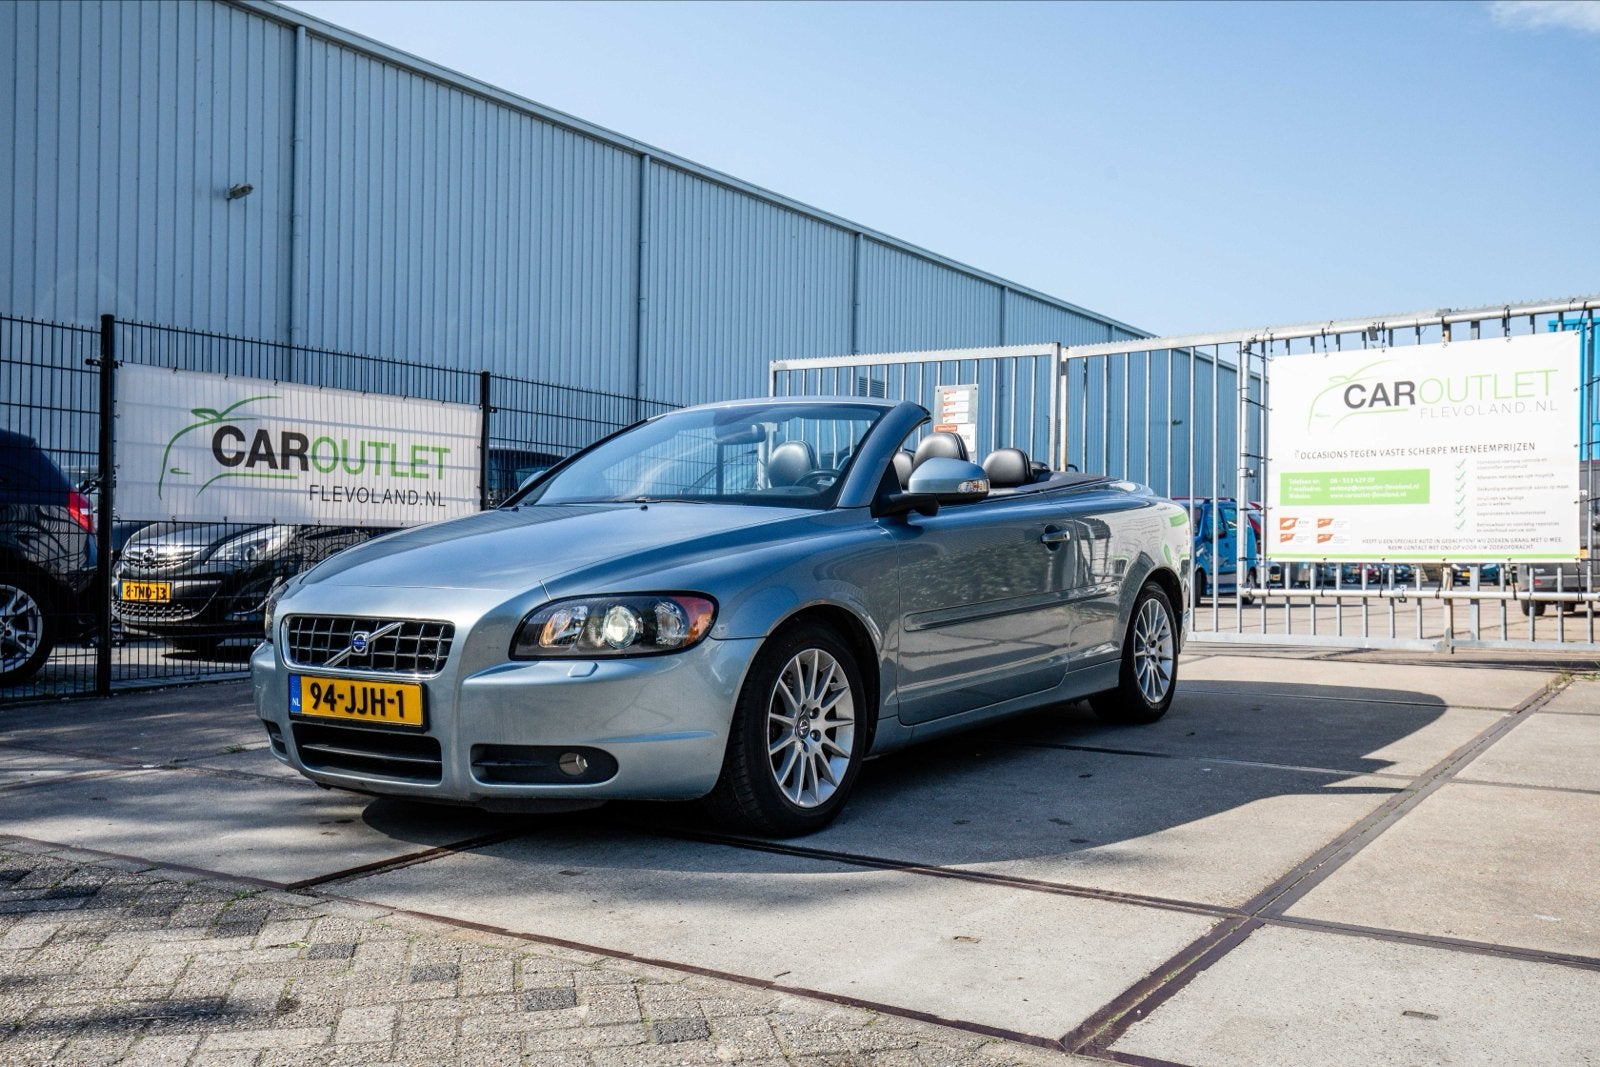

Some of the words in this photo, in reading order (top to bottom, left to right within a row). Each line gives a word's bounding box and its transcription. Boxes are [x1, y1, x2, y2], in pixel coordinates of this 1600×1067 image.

[1343, 369, 1559, 410] CAROUTLET
[1420, 400, 1559, 420] FLEVOLAND.NL
[211, 424, 451, 480] CAROUTLET
[1300, 450, 1348, 460] OCCASIONS
[1350, 448, 1377, 458] TEGEN
[1379, 447, 1405, 457] VASTE
[1408, 446, 1448, 456] SCHERPE
[1450, 442, 1536, 454] MEENEEMPRIJZEN
[309, 484, 447, 508] FLEVOLAND.NL
[292, 696, 301, 706] NL
[309, 681, 405, 718] 94-JJH-1
